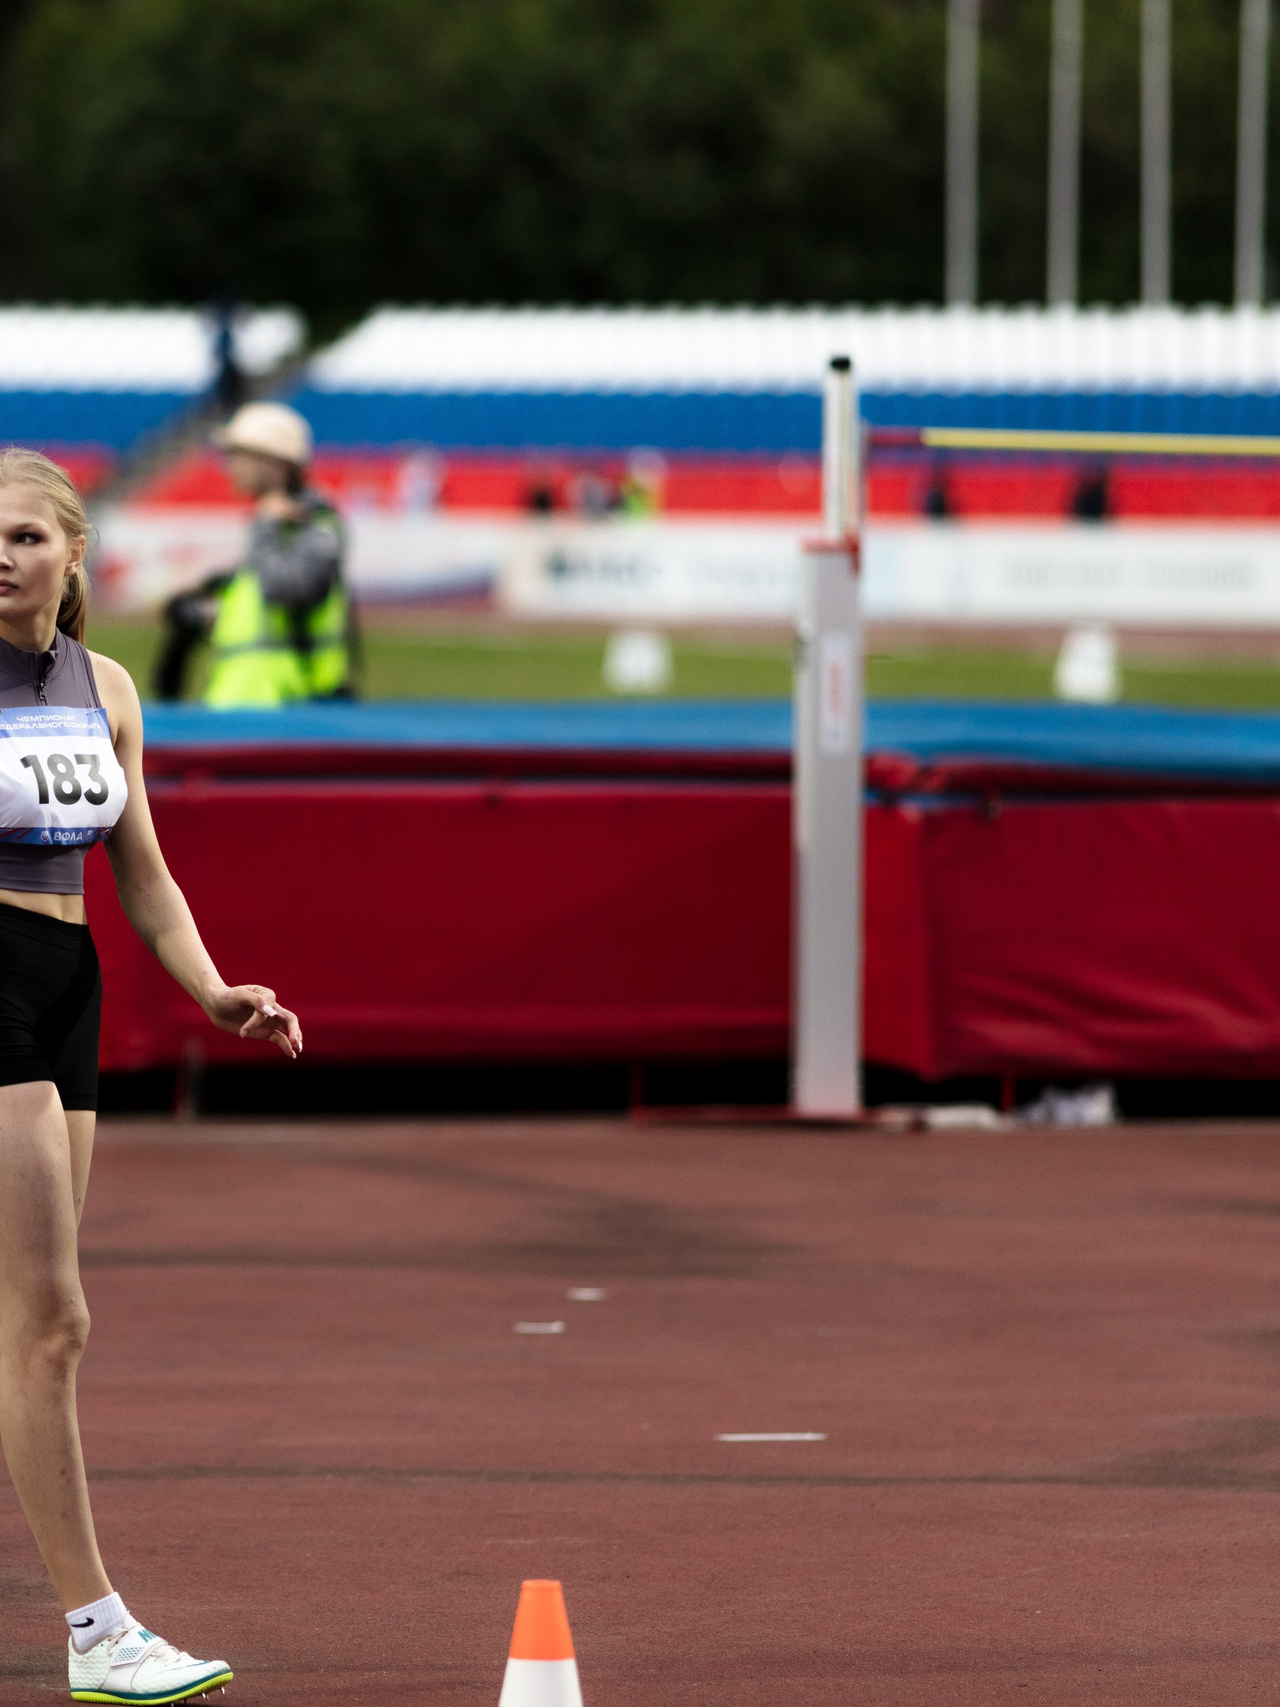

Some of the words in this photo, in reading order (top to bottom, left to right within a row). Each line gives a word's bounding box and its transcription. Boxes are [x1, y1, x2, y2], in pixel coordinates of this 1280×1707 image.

[16, 714, 75, 722] ЧЕМПИОНАТ
[20, 753, 109, 805] 183
[53, 831, 83, 841] ВФЛА
